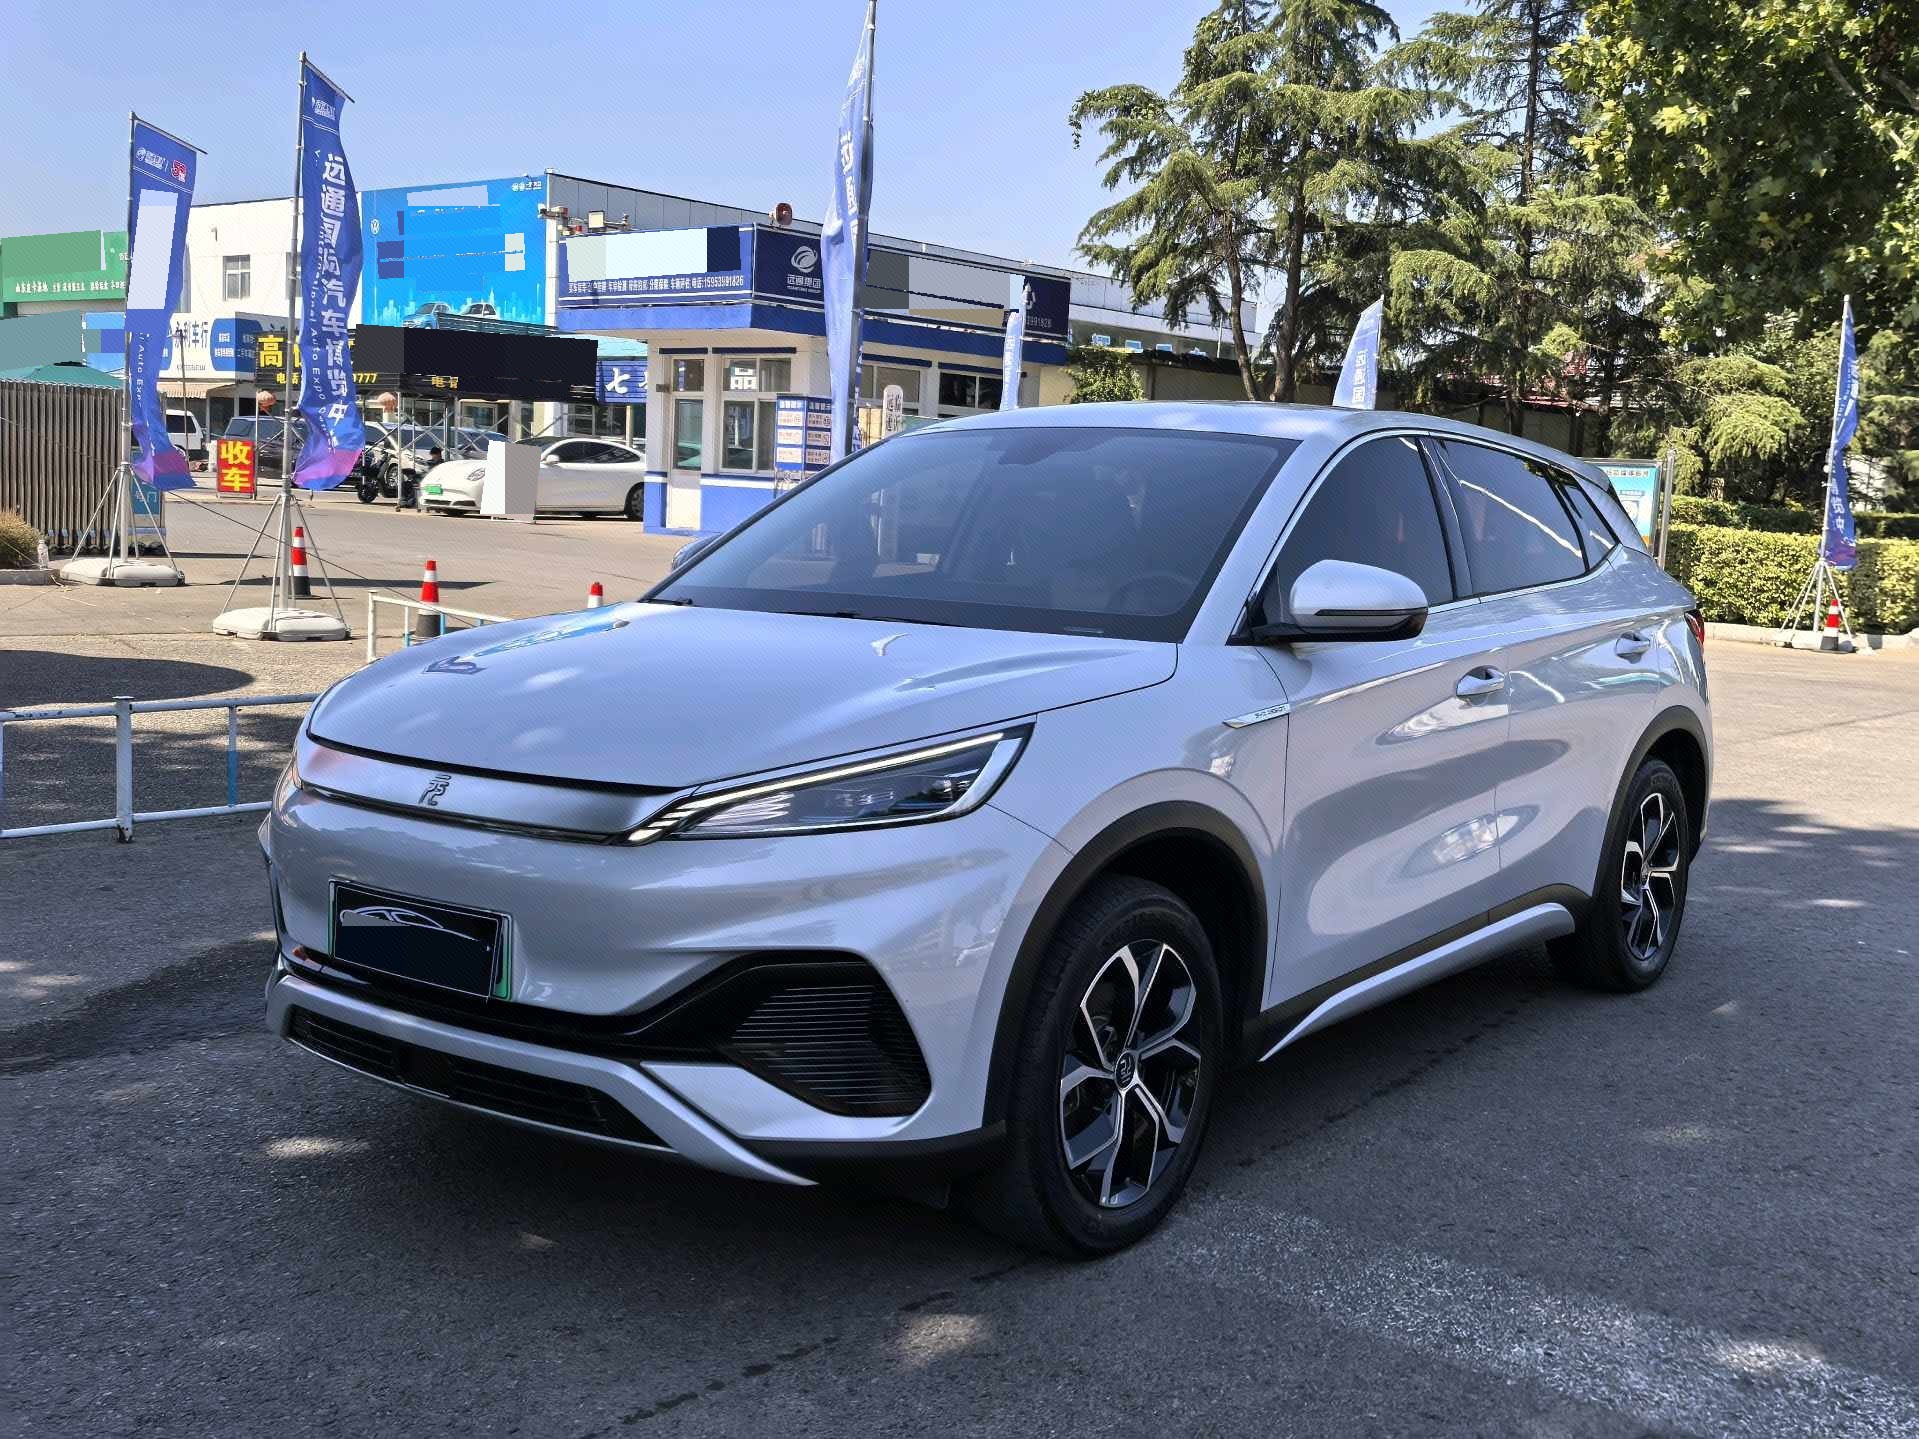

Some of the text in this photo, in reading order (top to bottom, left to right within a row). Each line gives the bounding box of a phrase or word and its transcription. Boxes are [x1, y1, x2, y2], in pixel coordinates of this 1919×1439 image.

[311, 328, 320, 361] Auto
[312, 367, 326, 400] Expo
[220, 440, 252, 492] 收车
